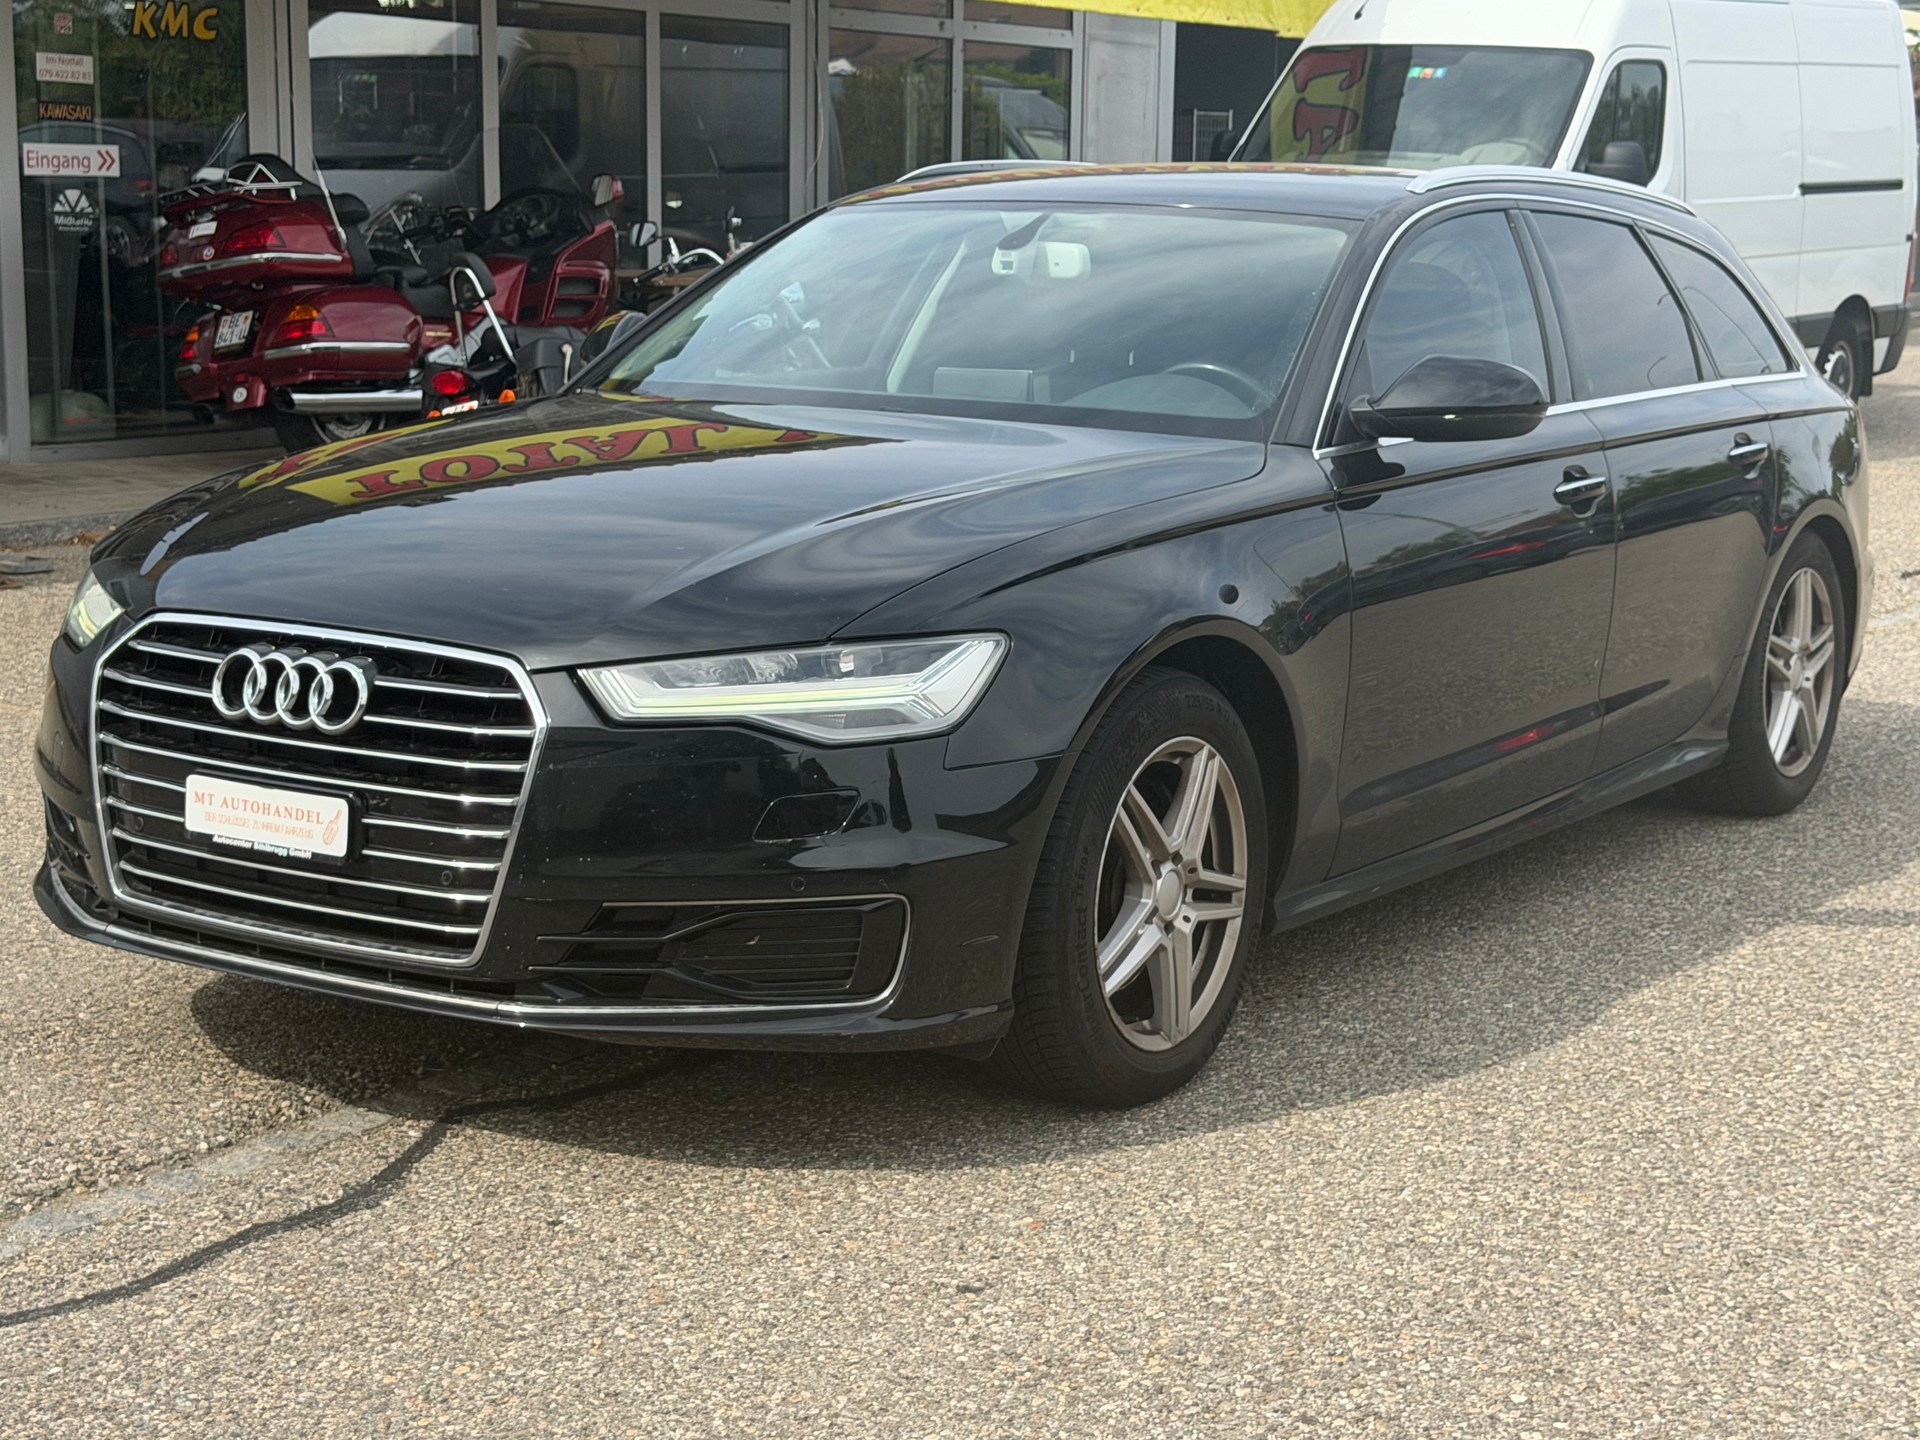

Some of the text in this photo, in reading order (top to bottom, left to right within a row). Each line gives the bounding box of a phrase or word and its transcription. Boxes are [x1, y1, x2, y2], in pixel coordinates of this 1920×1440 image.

[132, 0, 219, 41] KMC
[39, 103, 92, 120] KAWASAKI
[26, 149, 91, 173] Eingang
[194, 791, 324, 825] MT AUTOHANDEL
[204, 811, 216, 822] DER
